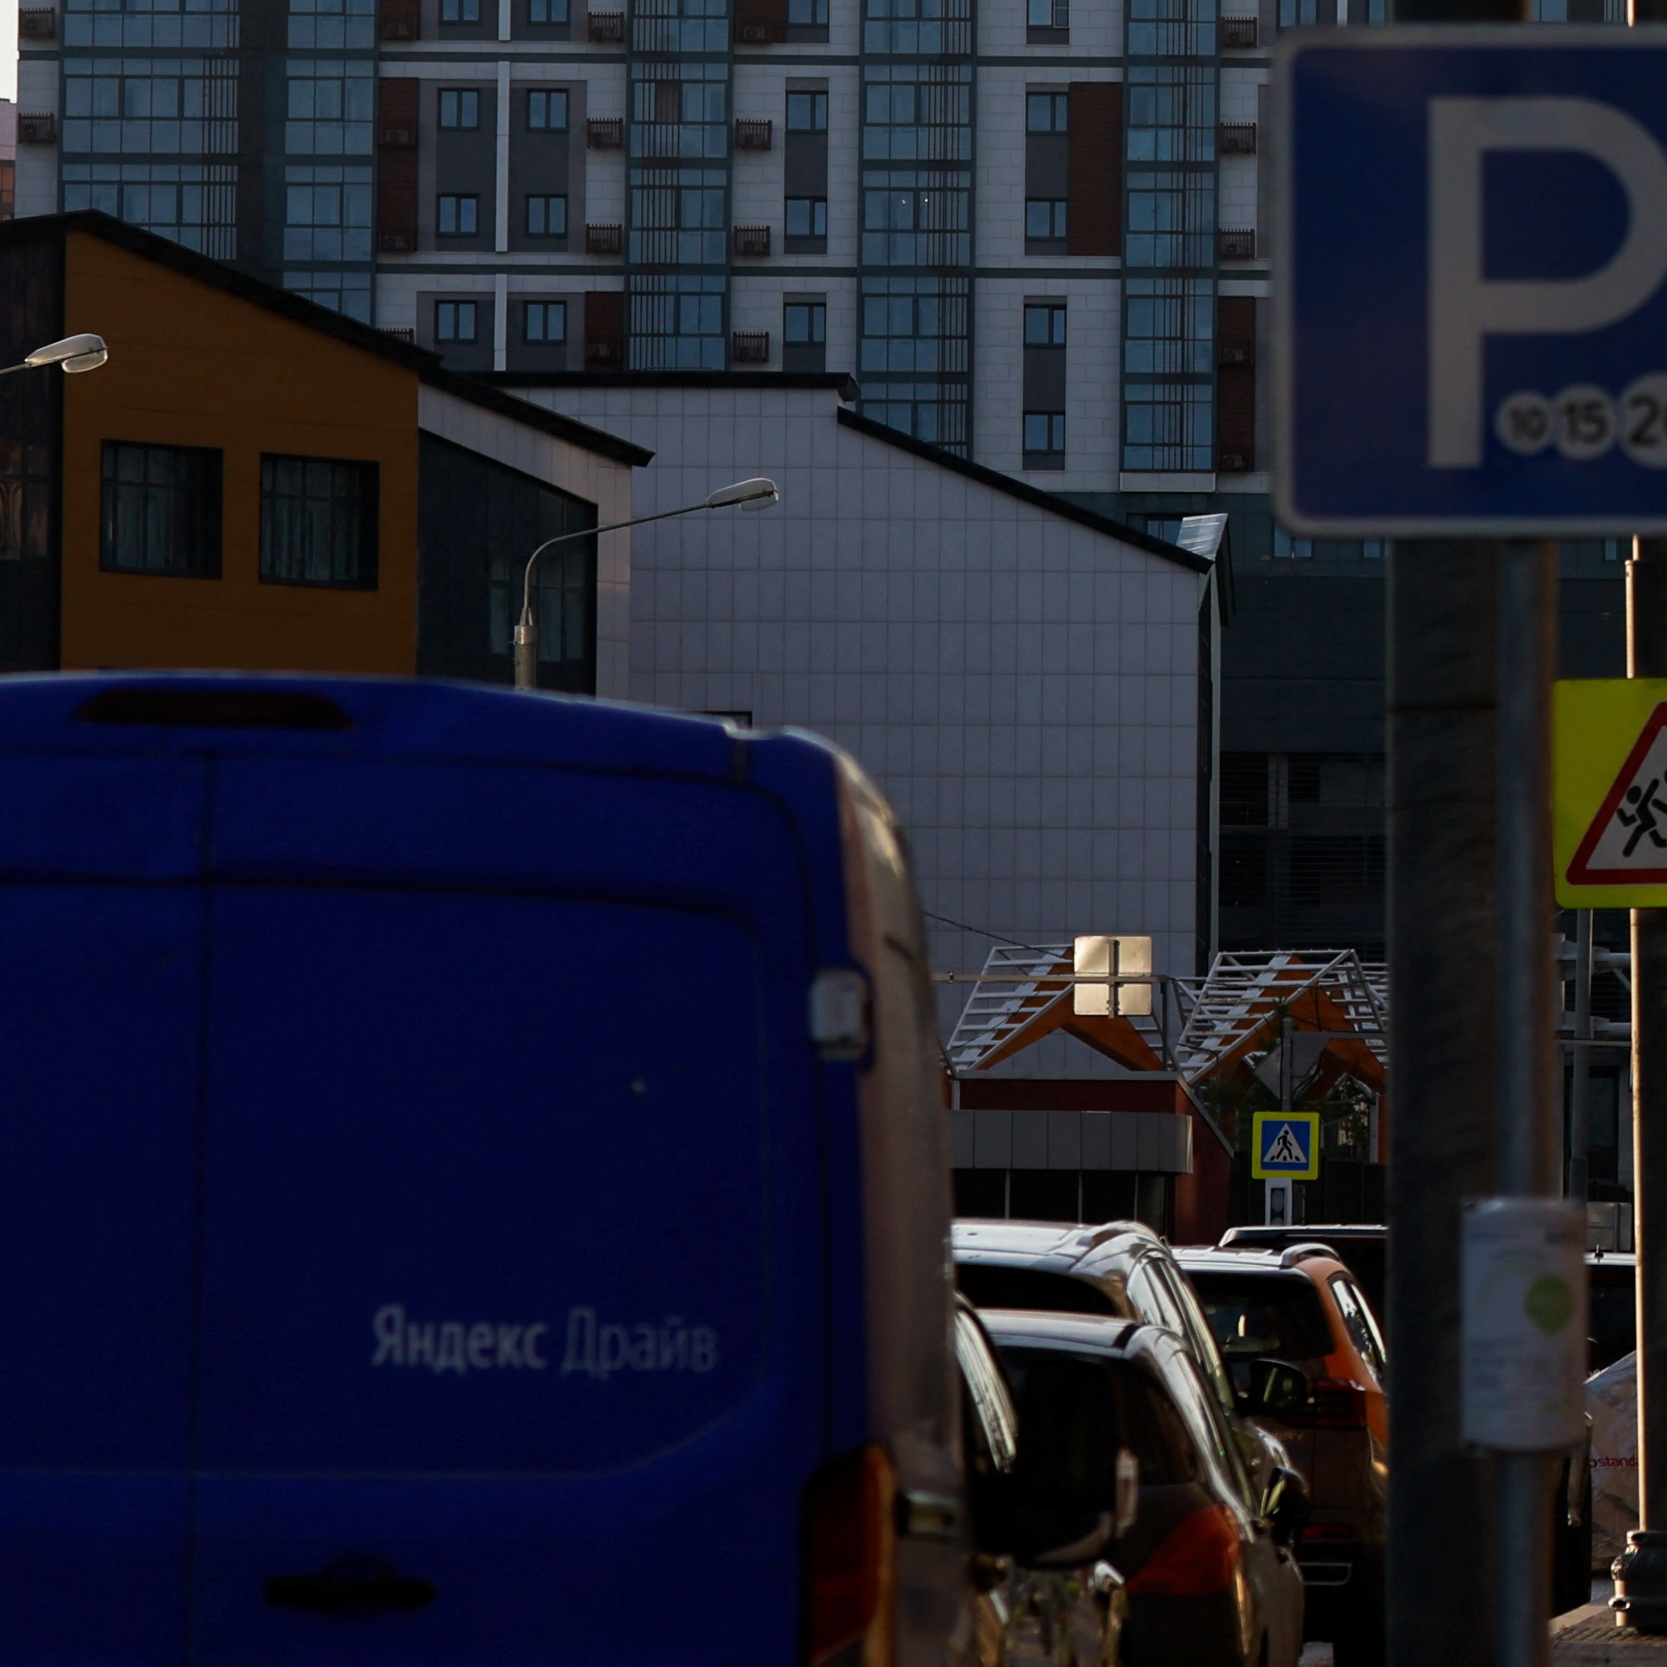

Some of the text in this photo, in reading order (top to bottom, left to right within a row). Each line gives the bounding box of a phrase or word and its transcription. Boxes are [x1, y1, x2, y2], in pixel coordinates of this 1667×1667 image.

[1510, 407, 1548, 442] 10
[1565, 401, 1608, 444] 15
[370, 1301, 722, 1382] Яндекс Драйв
[1588, 1455, 1638, 1469] ostand
